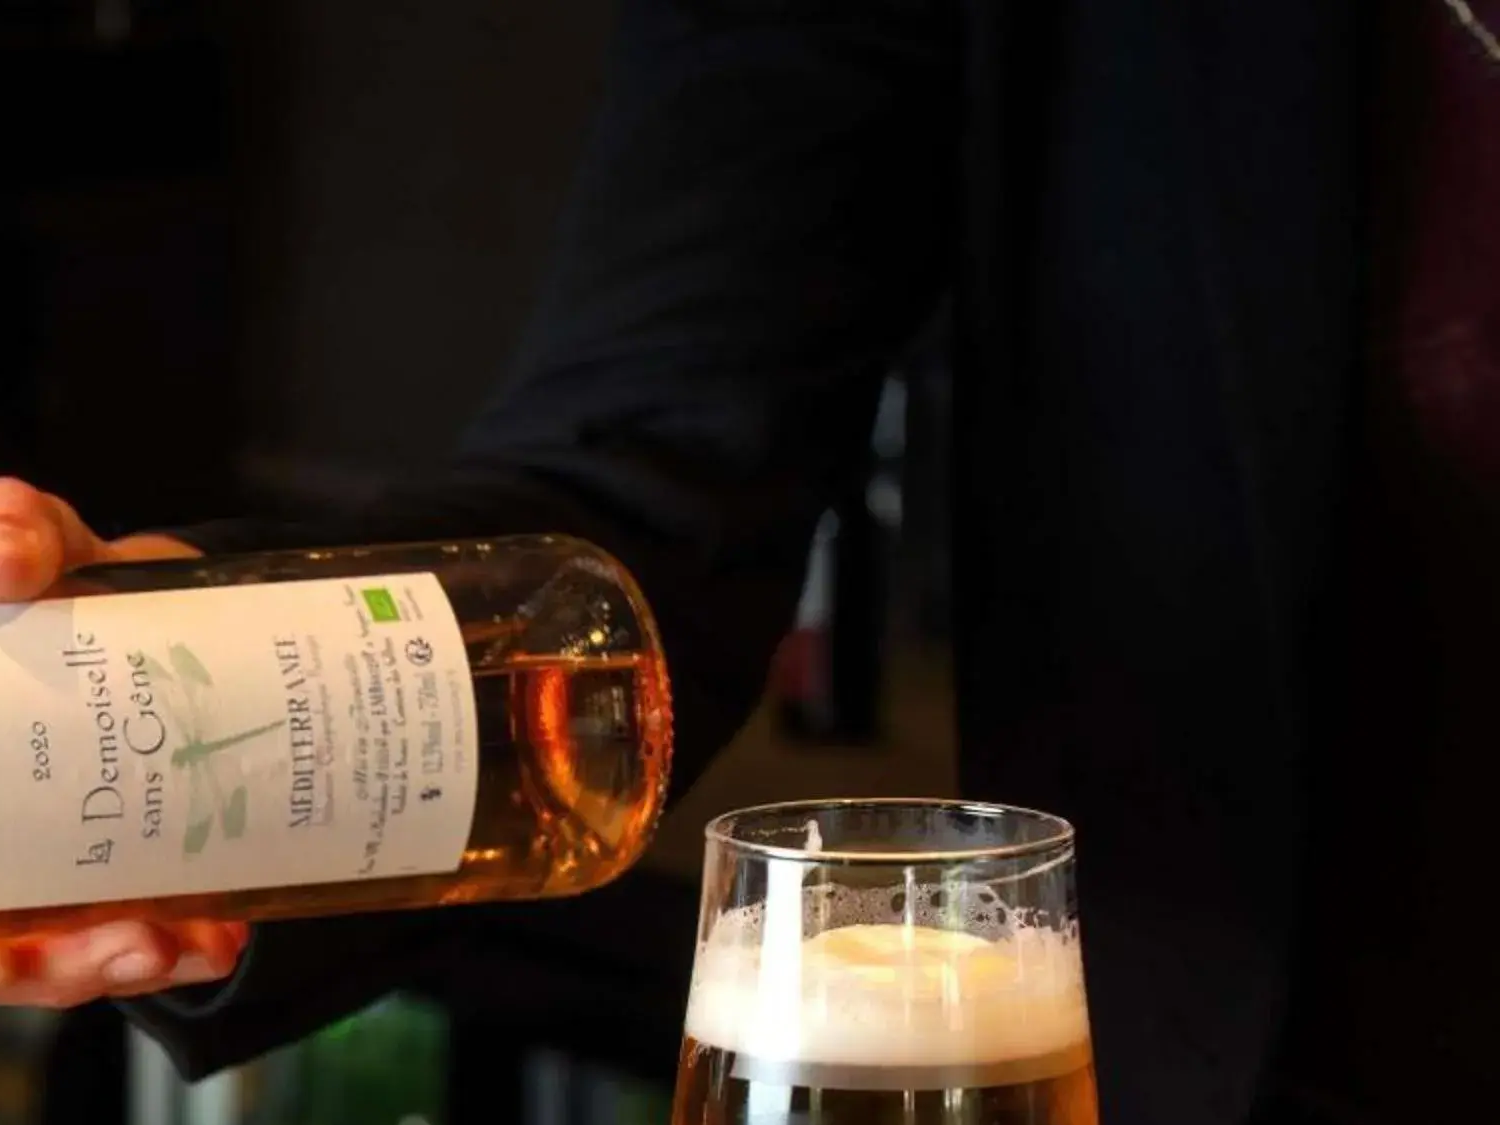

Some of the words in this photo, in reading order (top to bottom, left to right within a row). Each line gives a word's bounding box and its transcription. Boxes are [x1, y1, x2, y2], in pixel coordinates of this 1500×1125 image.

[62, 632, 124, 826] Demoiselle
[123, 652, 166, 756] Gêne
[31, 720, 51, 781] 2020
[142, 771, 164, 839] sans
